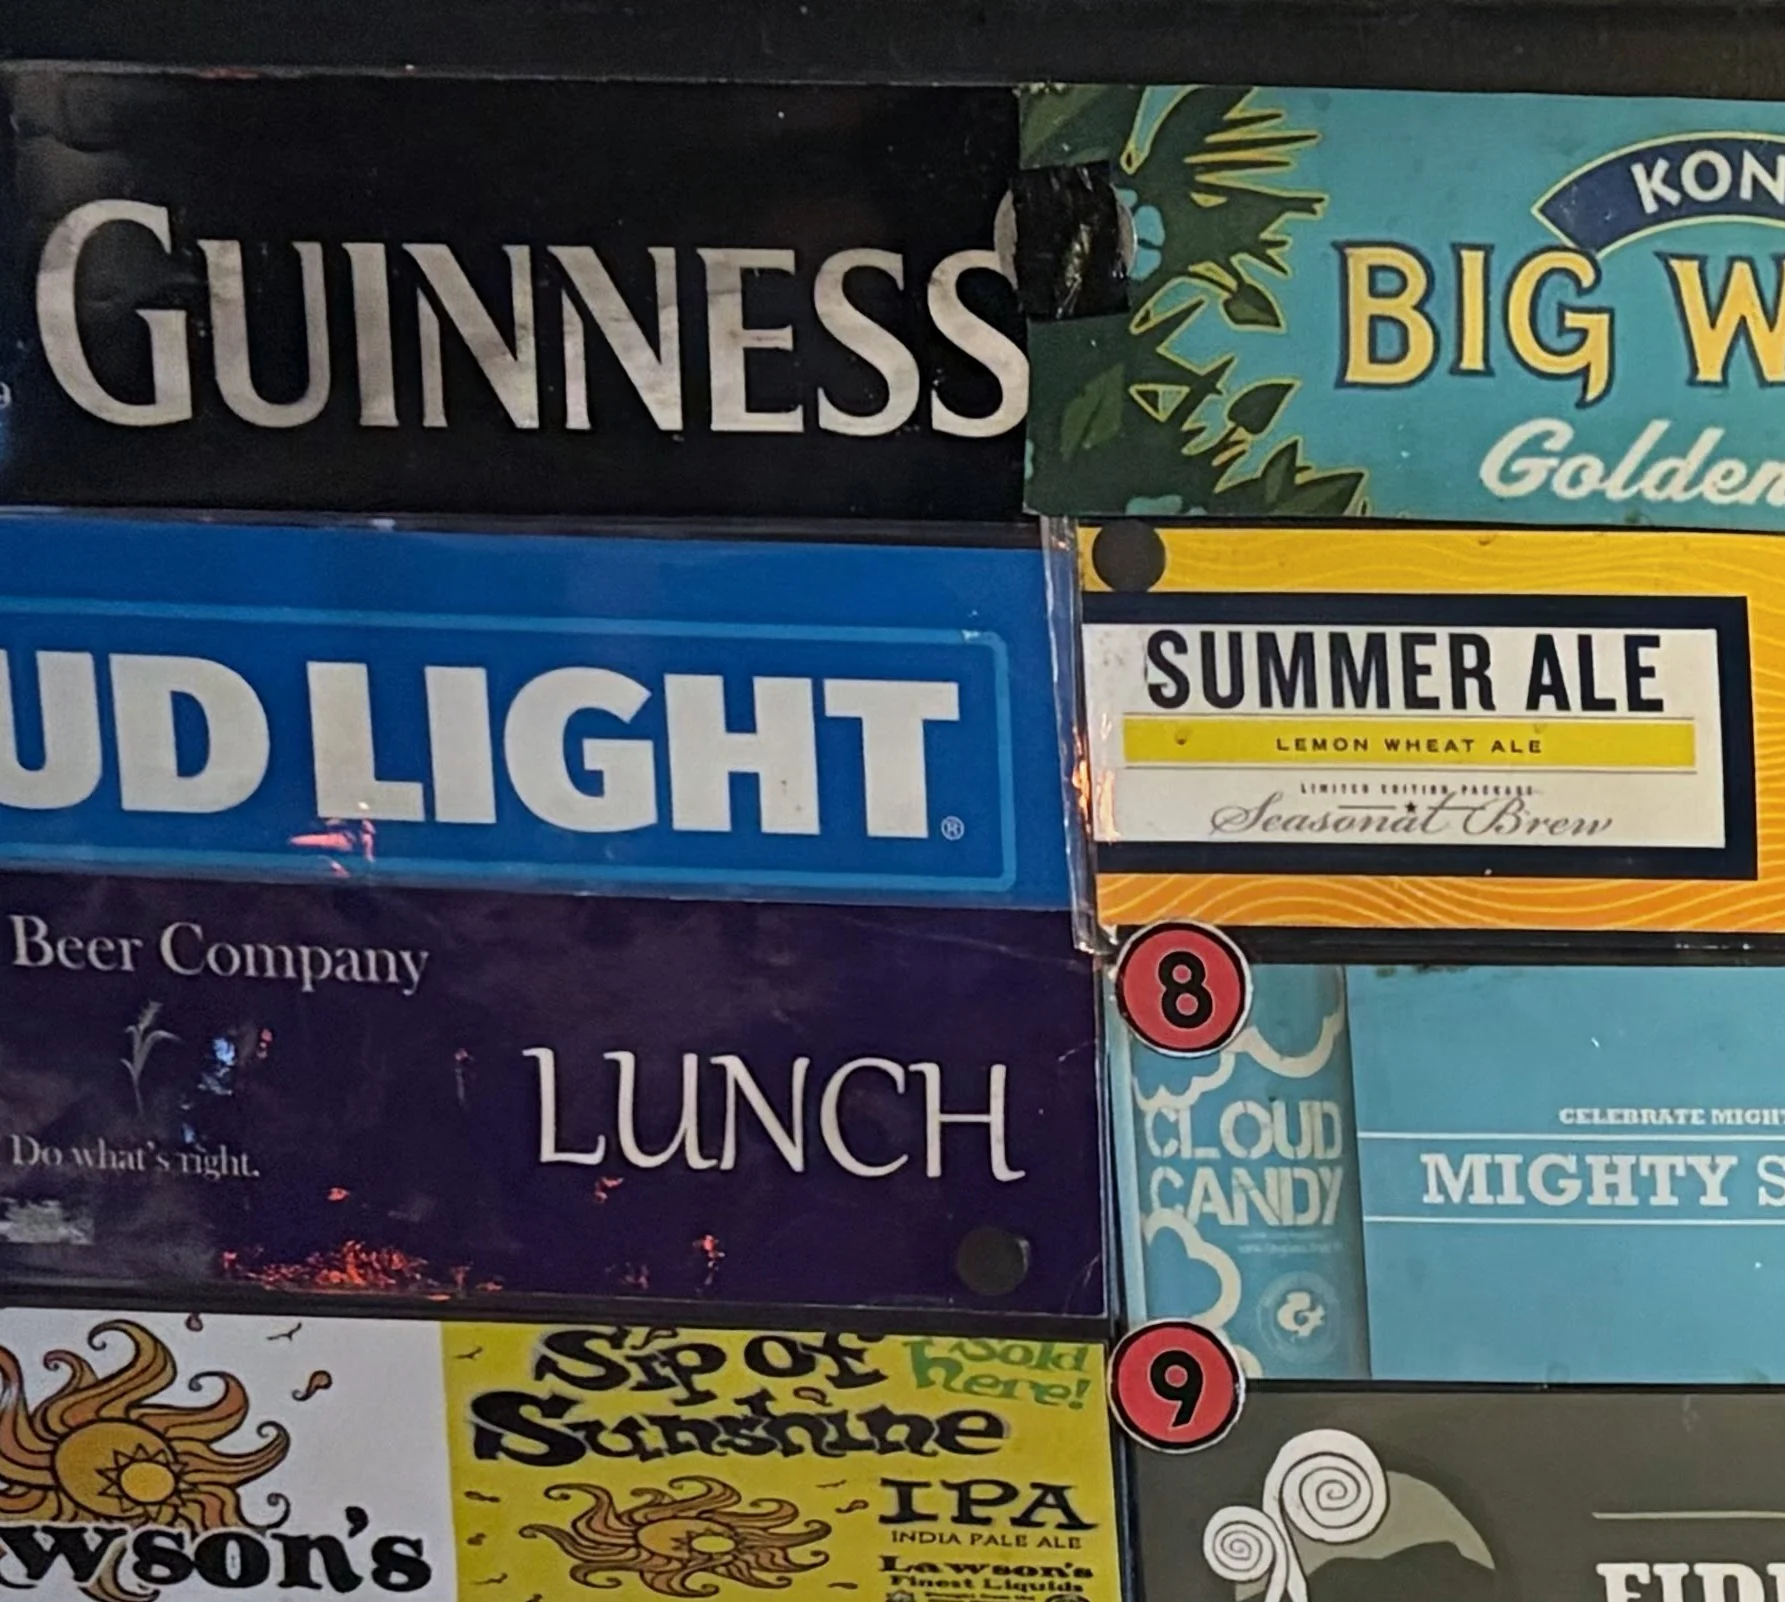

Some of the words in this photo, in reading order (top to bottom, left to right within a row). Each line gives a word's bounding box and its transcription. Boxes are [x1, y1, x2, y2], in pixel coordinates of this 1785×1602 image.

[36, 199, 1030, 440] GUINNESS
[1336, 243, 1609, 404] BIG
[1147, 630, 1496, 712] SUMMER
[1525, 633, 1665, 712] ALE
[307, 661, 959, 839] LIGHT
[1275, 736, 1372, 752] LEMON
[1385, 737, 1466, 754] WHEAT
[1478, 739, 1541, 755] ALE
[12, 916, 142, 973] Beer
[160, 921, 429, 997] Company
[1157, 952, 1214, 1018] 8
[523, 1047, 1024, 1181] LUNCH
[1559, 1108, 1705, 1126] CELEBRATE
[12, 1136, 61, 1168] Do
[70, 1141, 169, 1174] what's
[179, 1146, 261, 1180] right.
[1423, 1154, 1733, 1206] MIGHTY
[1152, 1352, 1205, 1428] 9
[471, 1390, 1006, 1468] Sunshine
[878, 1478, 1098, 1530] IPA
[891, 1531, 962, 1545] INDIA
[969, 1532, 1025, 1547] PALE
[1037, 1534, 1081, 1548] ALE
